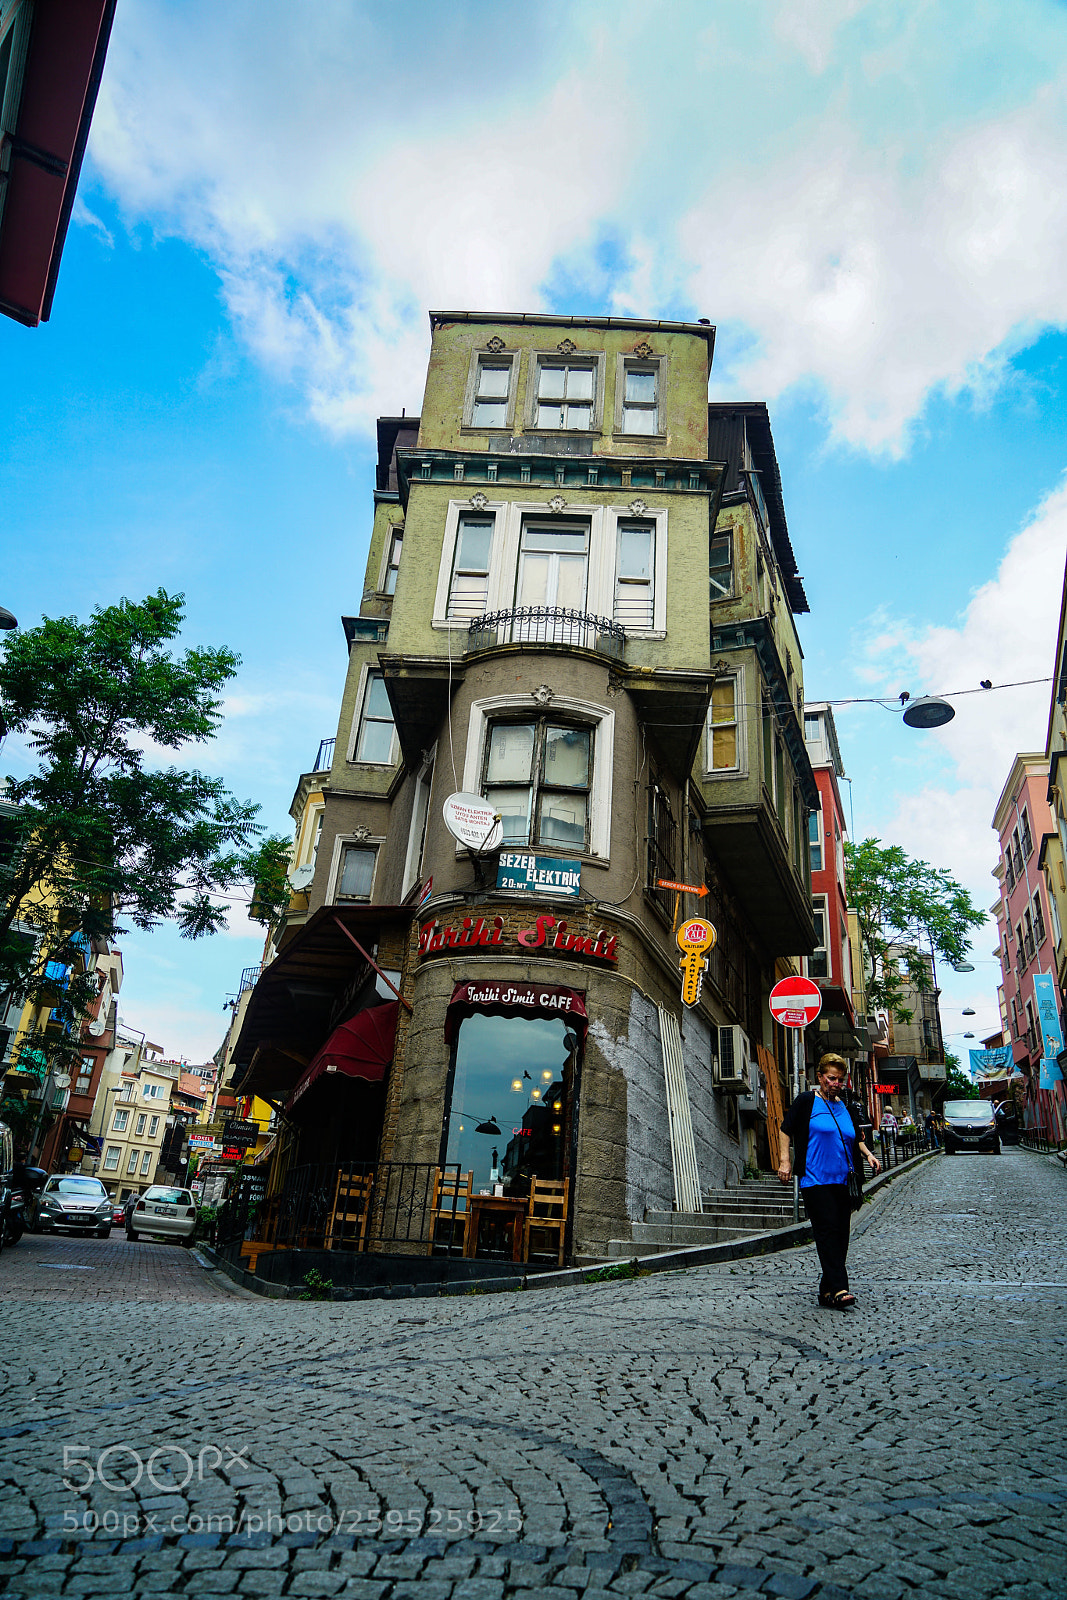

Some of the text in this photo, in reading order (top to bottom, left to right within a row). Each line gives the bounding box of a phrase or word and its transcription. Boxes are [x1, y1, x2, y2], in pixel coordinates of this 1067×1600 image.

[499, 853, 536, 869] SEZER
[526, 868, 581, 887] ELEKTRİK
[417, 915, 619, 961] Tarihi Simit
[467, 986, 572, 1010] Tarihi Simit CAFE
[512, 1127, 532, 1137] CAFE
[241, 1174, 267, 1182] OSMAN
